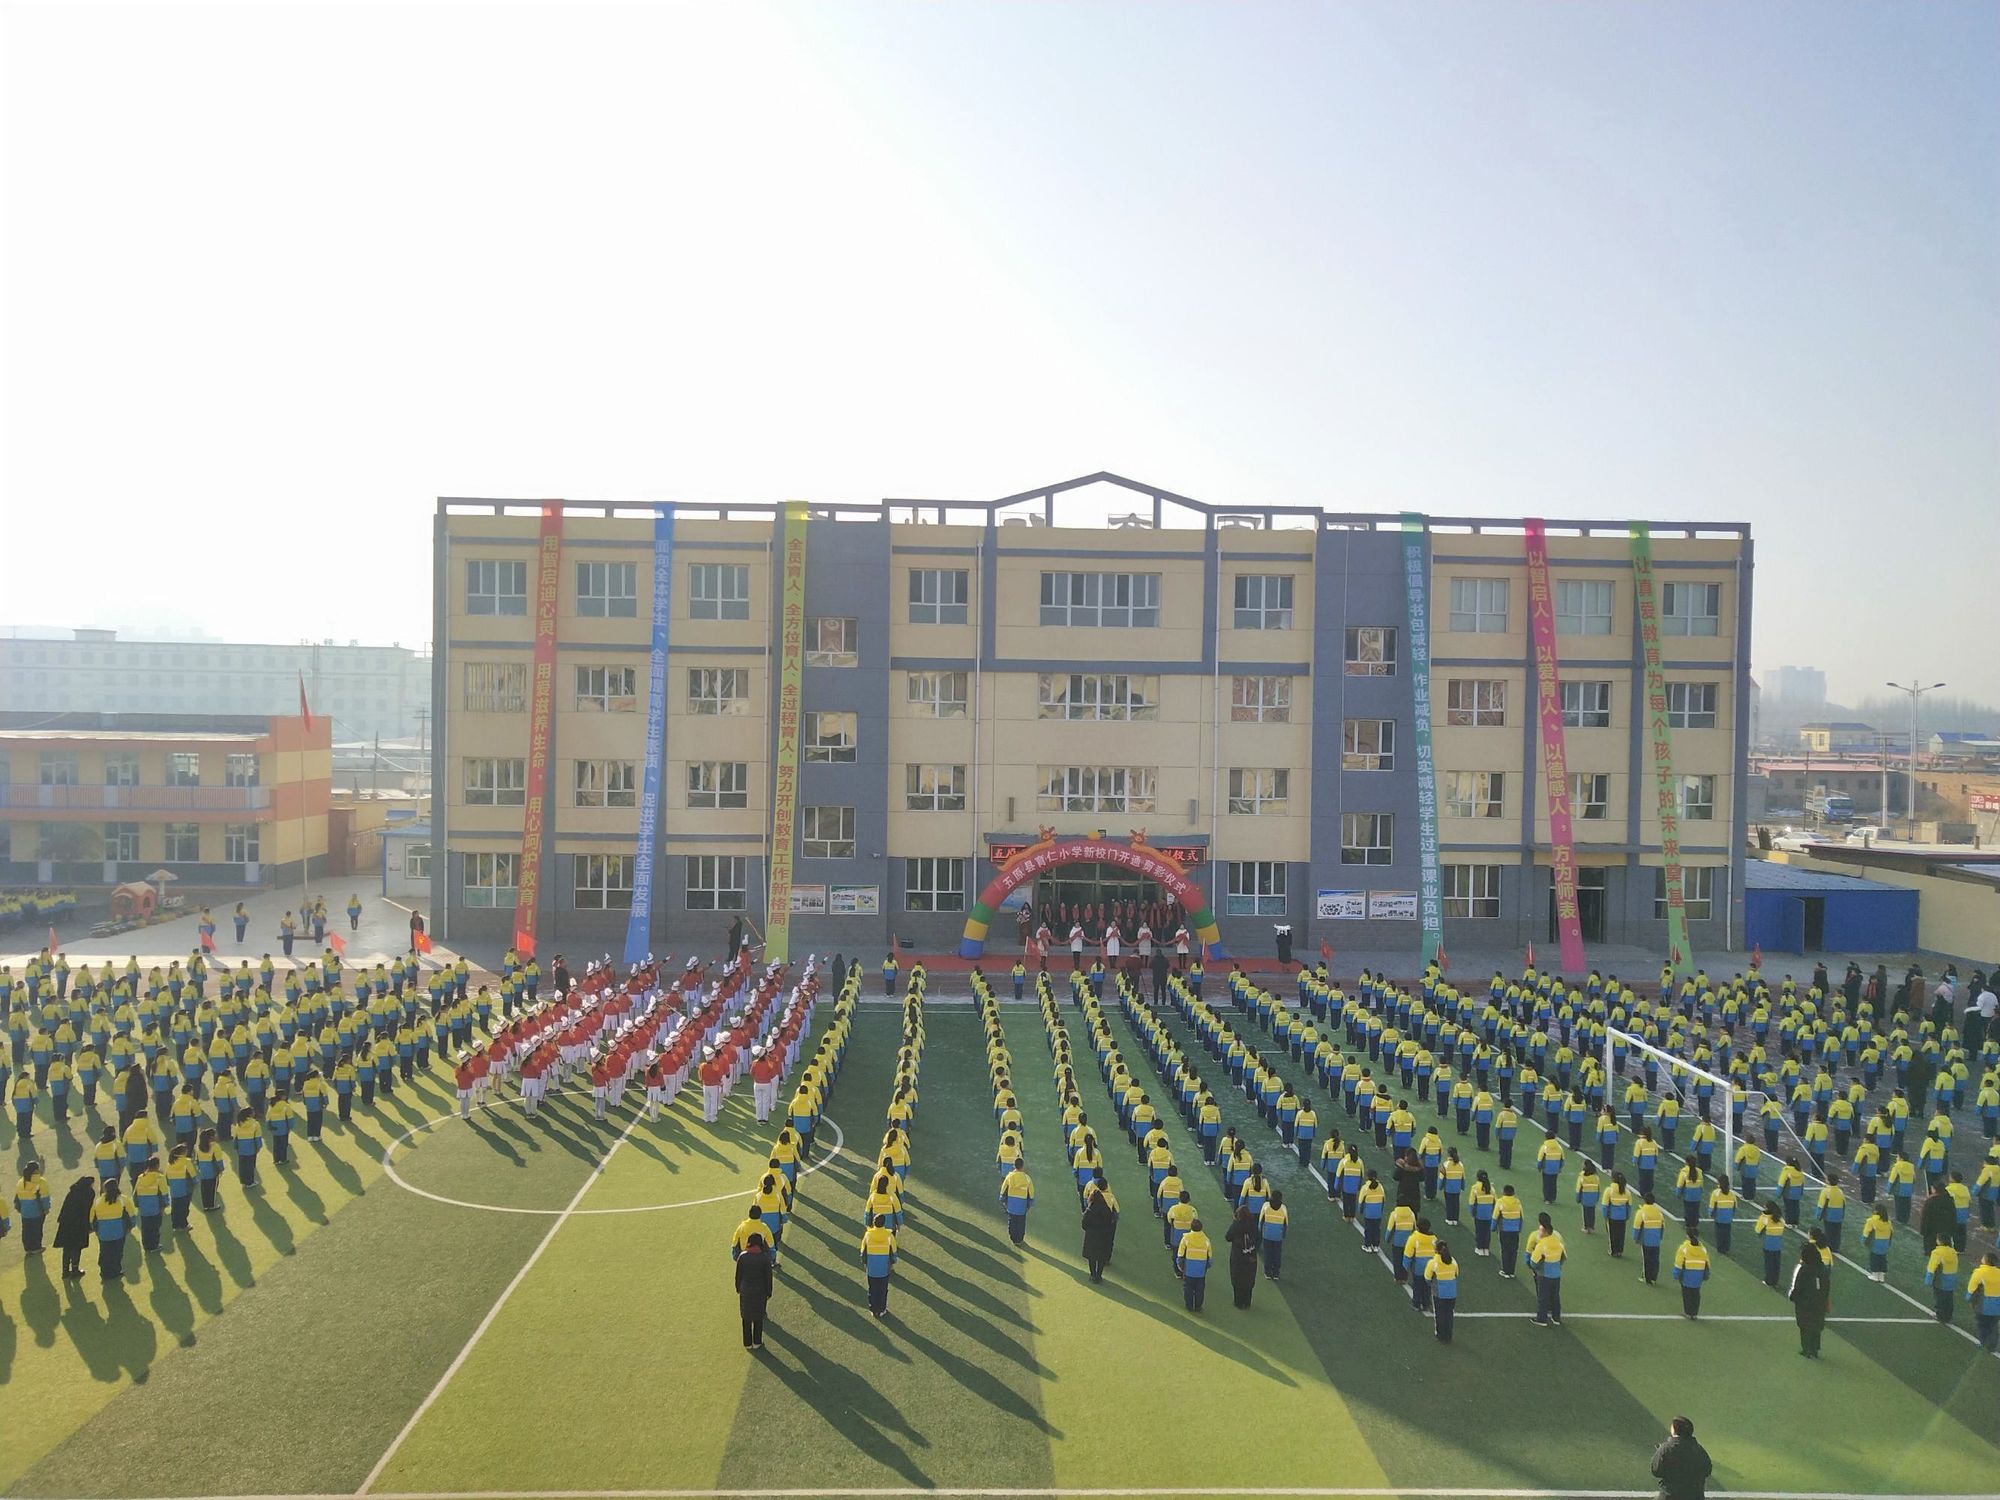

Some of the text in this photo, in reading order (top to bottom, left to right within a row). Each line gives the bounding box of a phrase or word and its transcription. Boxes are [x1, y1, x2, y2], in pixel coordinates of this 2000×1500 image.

[1002, 846, 1188, 895] 五原县育仁小学新校门开通剪彩仪式
